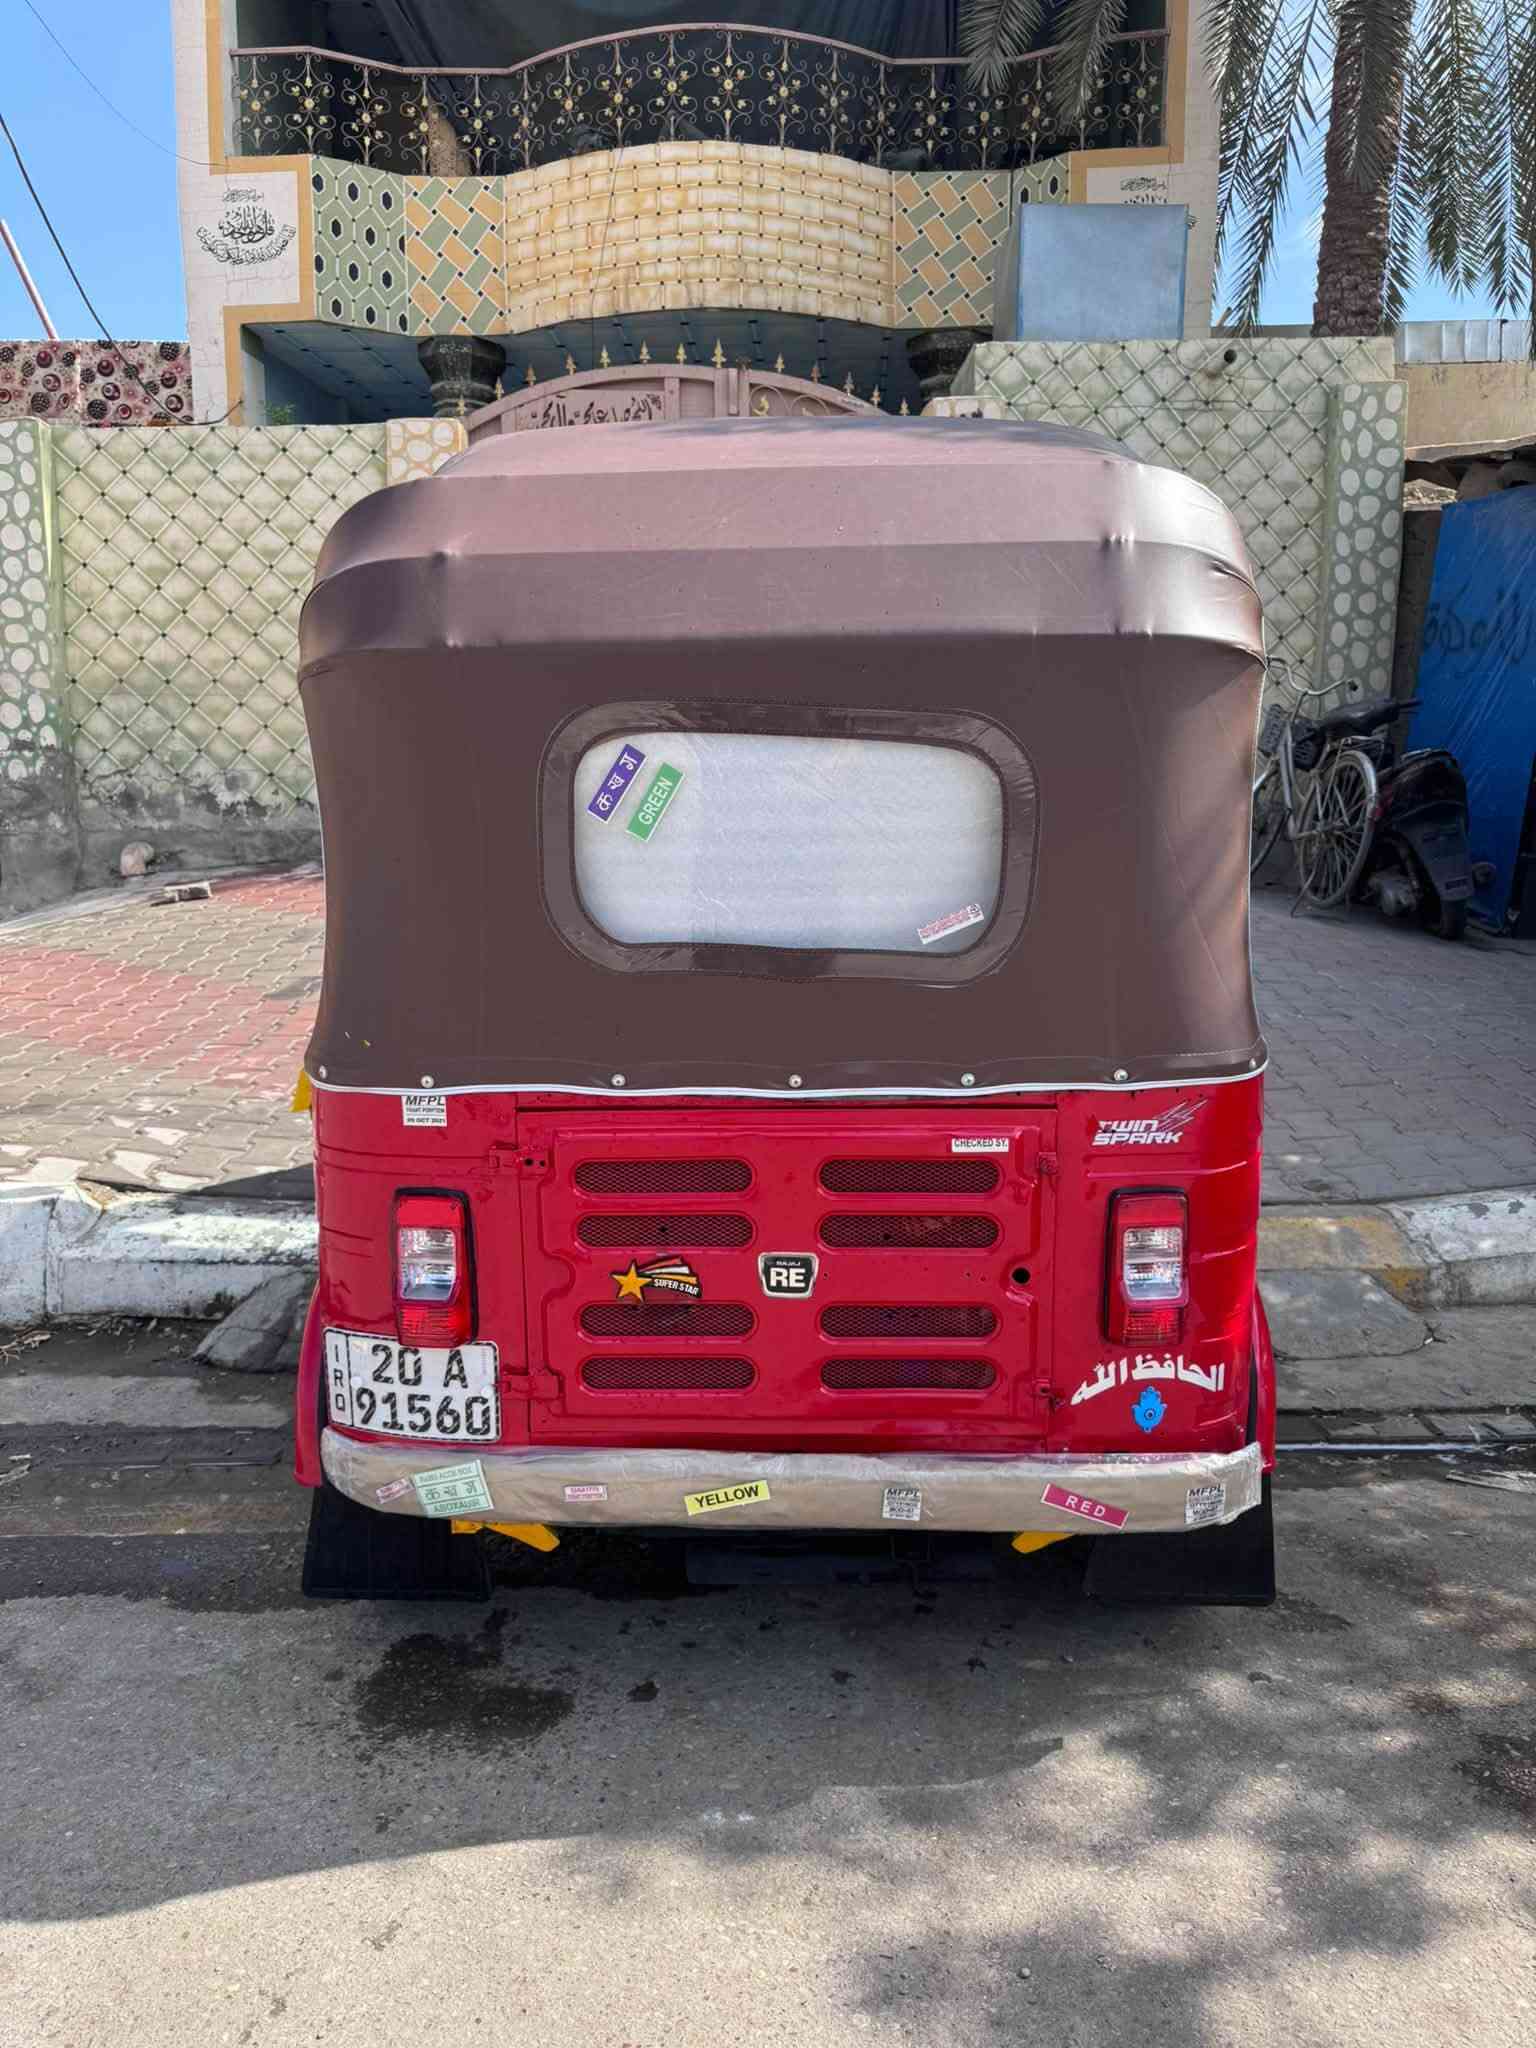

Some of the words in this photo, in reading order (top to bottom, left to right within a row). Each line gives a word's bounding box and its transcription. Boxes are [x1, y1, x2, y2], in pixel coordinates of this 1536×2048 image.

[638, 776, 673, 825] GREEN
[405, 1095, 445, 1106] MFPL
[1092, 1131, 1183, 1146] SPARK
[654, 1278, 679, 1290] SUPER
[680, 1283, 699, 1296] STAR
[770, 1267, 806, 1288] RE
[371, 1343, 423, 1387] 20
[443, 1349, 469, 1390] A
[1131, 1352, 1225, 1393] الحافظ
[1070, 1355, 1128, 1406] الله
[355, 1386, 492, 1437] 91560
[695, 1484, 760, 1509] YELLOW
[1065, 1494, 1107, 1518] RED
